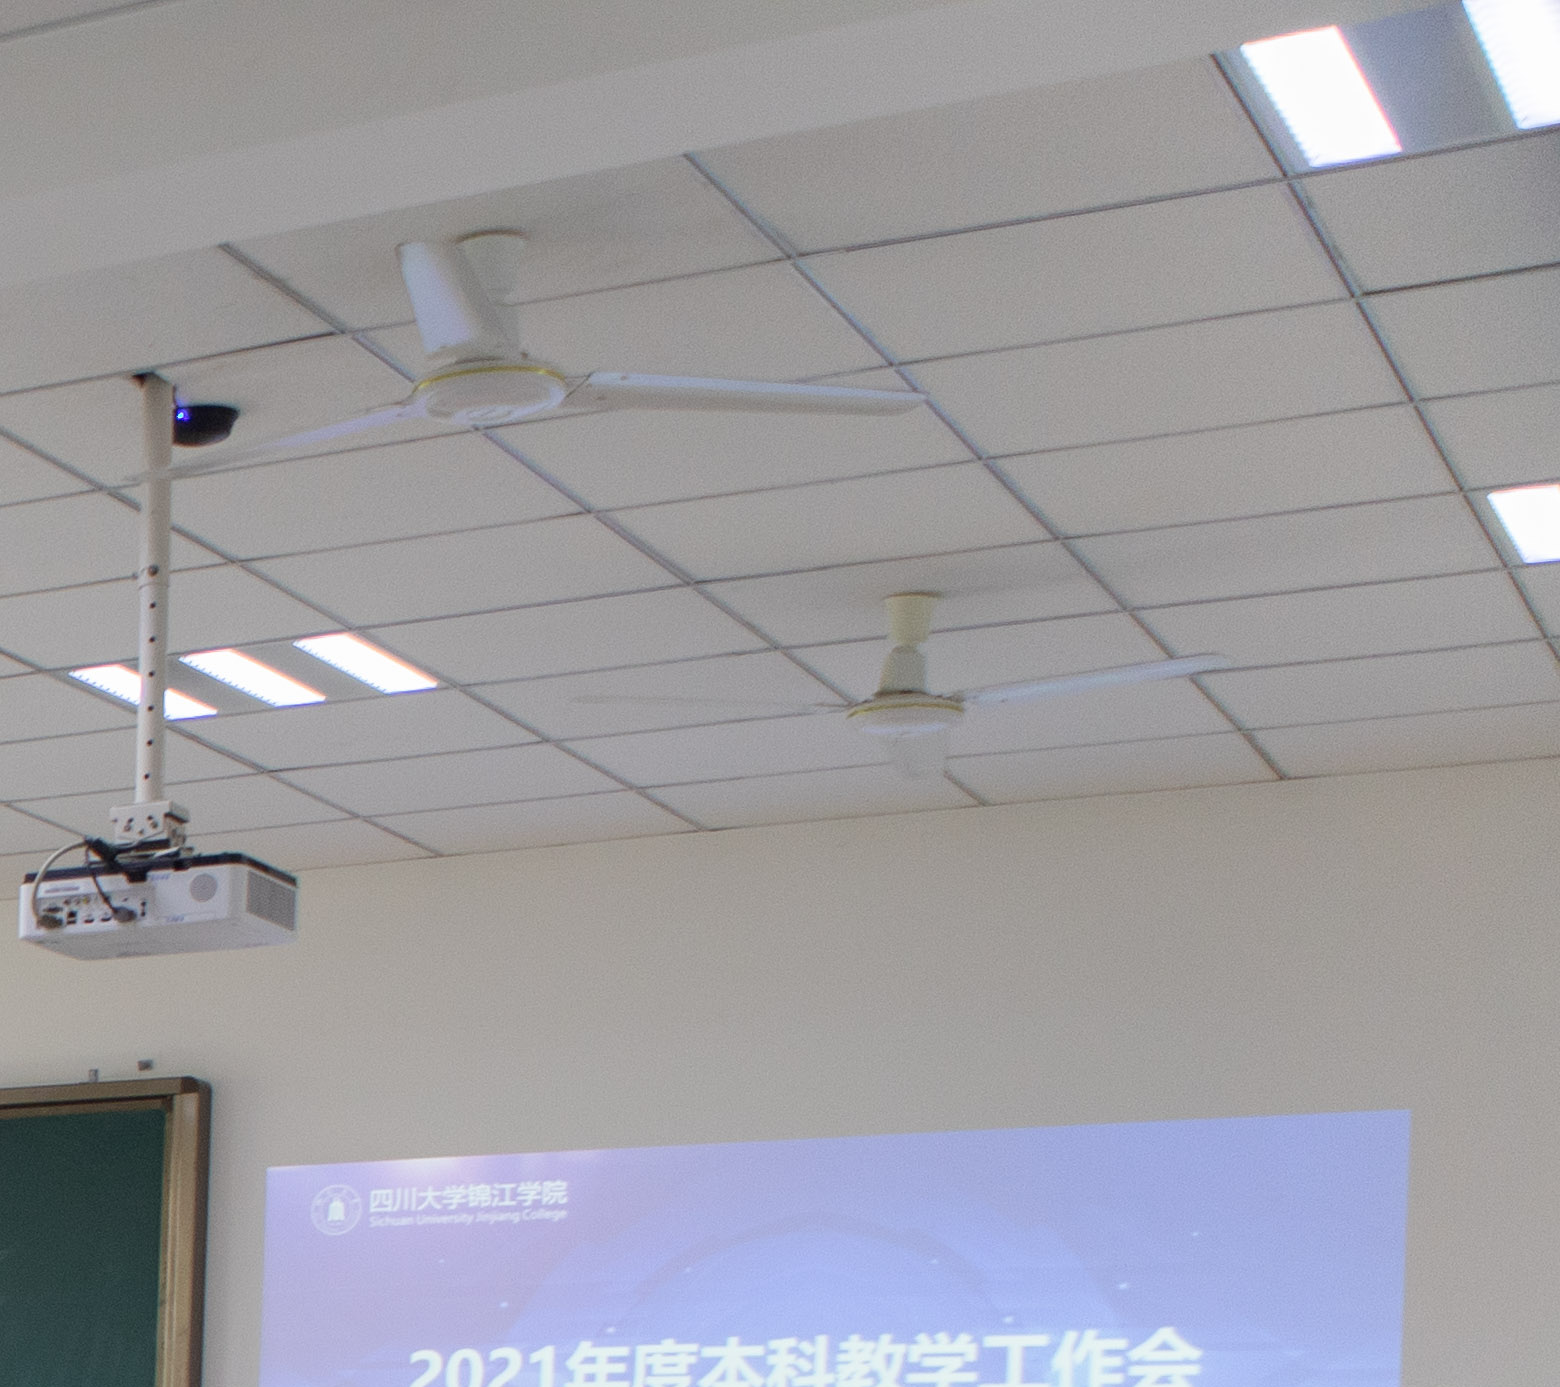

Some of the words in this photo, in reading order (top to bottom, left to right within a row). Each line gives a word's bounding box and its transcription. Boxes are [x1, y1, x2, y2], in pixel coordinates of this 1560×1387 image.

[370, 1180, 568, 1212] 四川大学锦江学院
[370, 1215, 414, 1228] Sichuan
[417, 1213, 474, 1226] University
[522, 1208, 568, 1222] College
